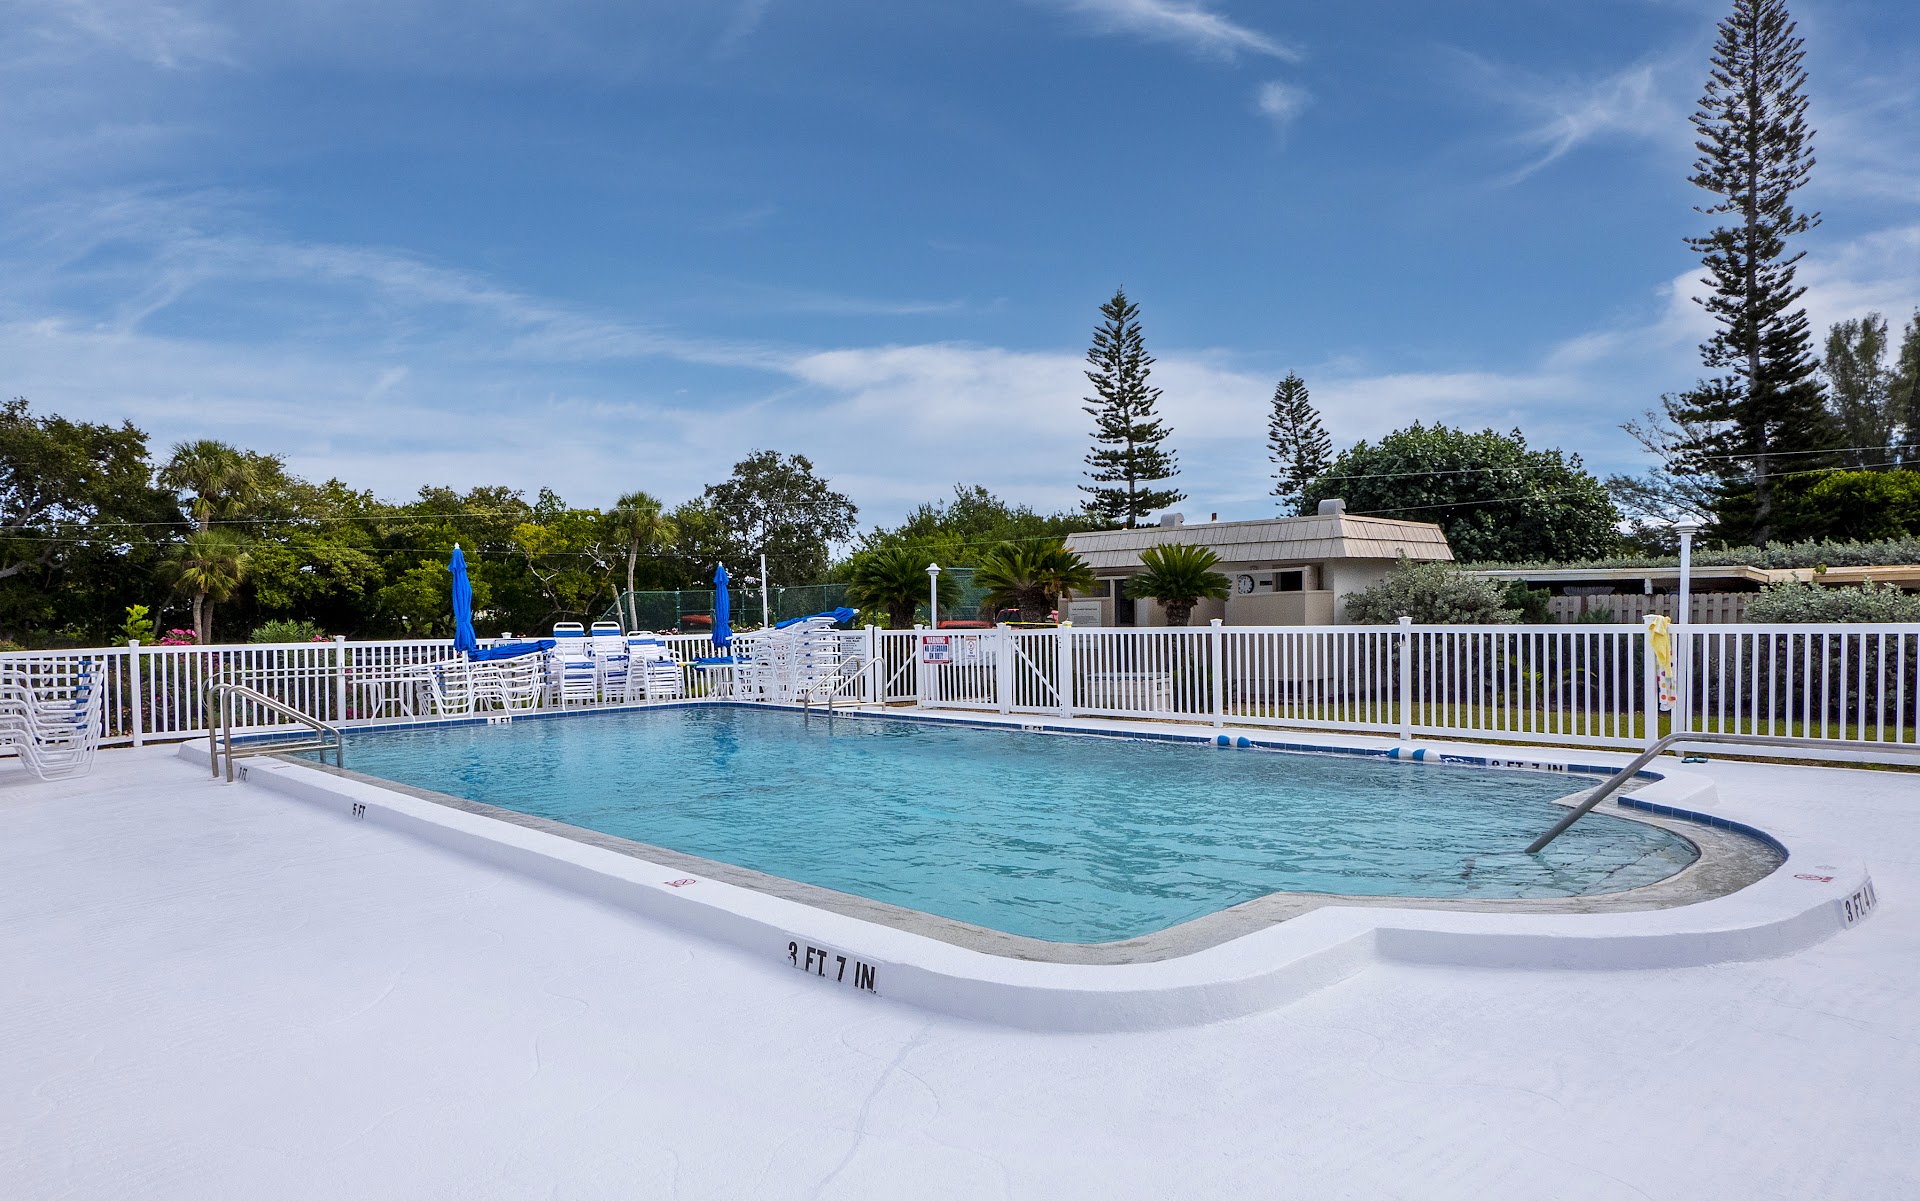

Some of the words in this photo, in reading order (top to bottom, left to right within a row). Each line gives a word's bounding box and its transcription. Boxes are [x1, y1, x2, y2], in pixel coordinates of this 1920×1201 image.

[926, 636, 946, 644] WARNING
[352, 803, 358, 816] 5
[1845, 900, 1854, 922] 3
[787, 941, 798, 967] 3
[836, 955, 847, 983] 7
